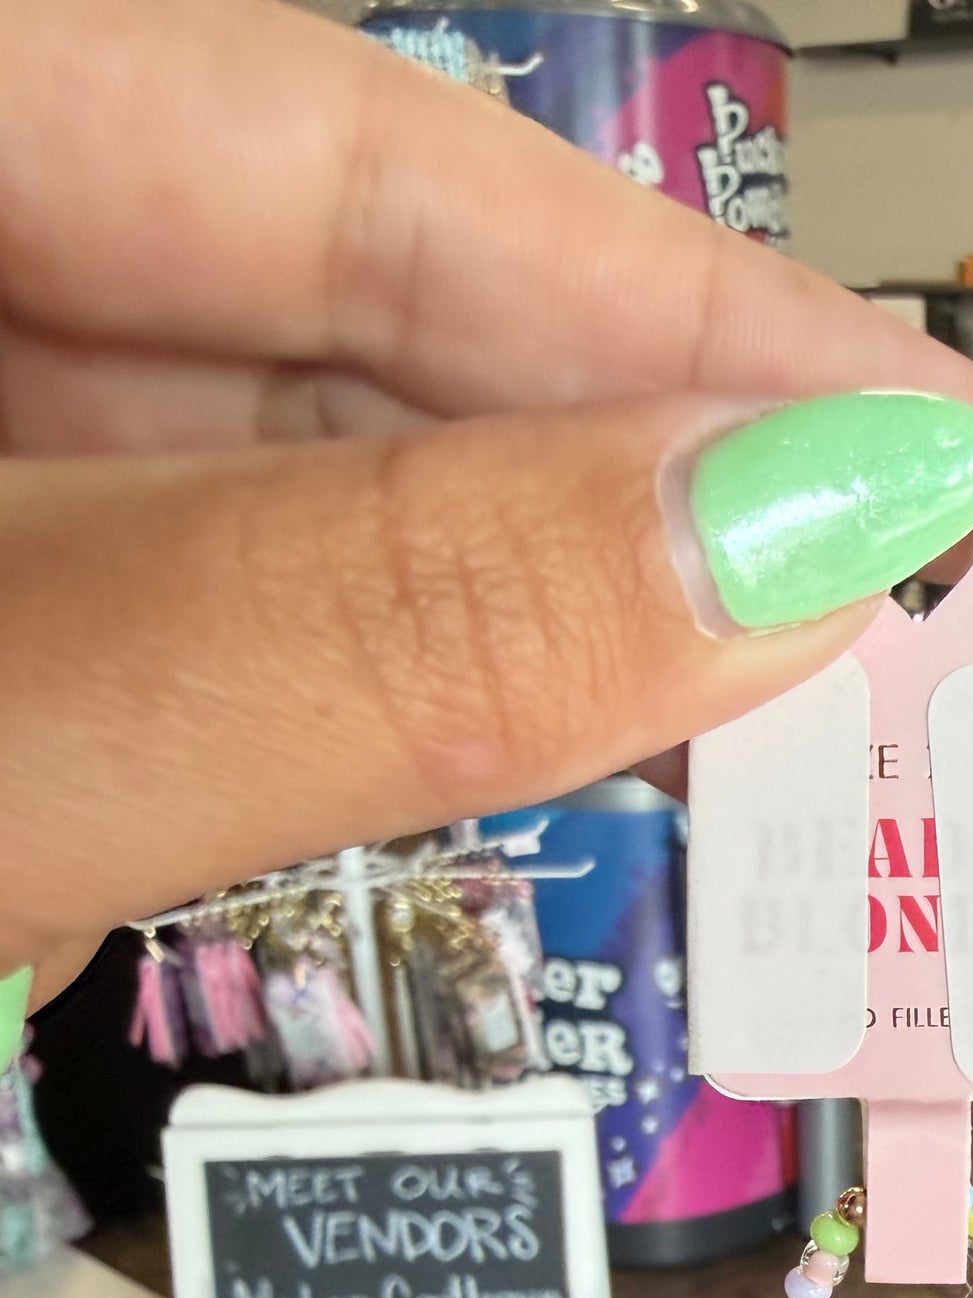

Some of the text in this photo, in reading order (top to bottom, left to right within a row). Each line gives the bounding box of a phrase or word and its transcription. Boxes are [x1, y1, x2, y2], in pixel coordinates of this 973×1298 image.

[892, 1007, 950, 1028] FILLE
[245, 1164, 501, 1208] MEET OUR
[284, 1206, 540, 1268] VENDORS
